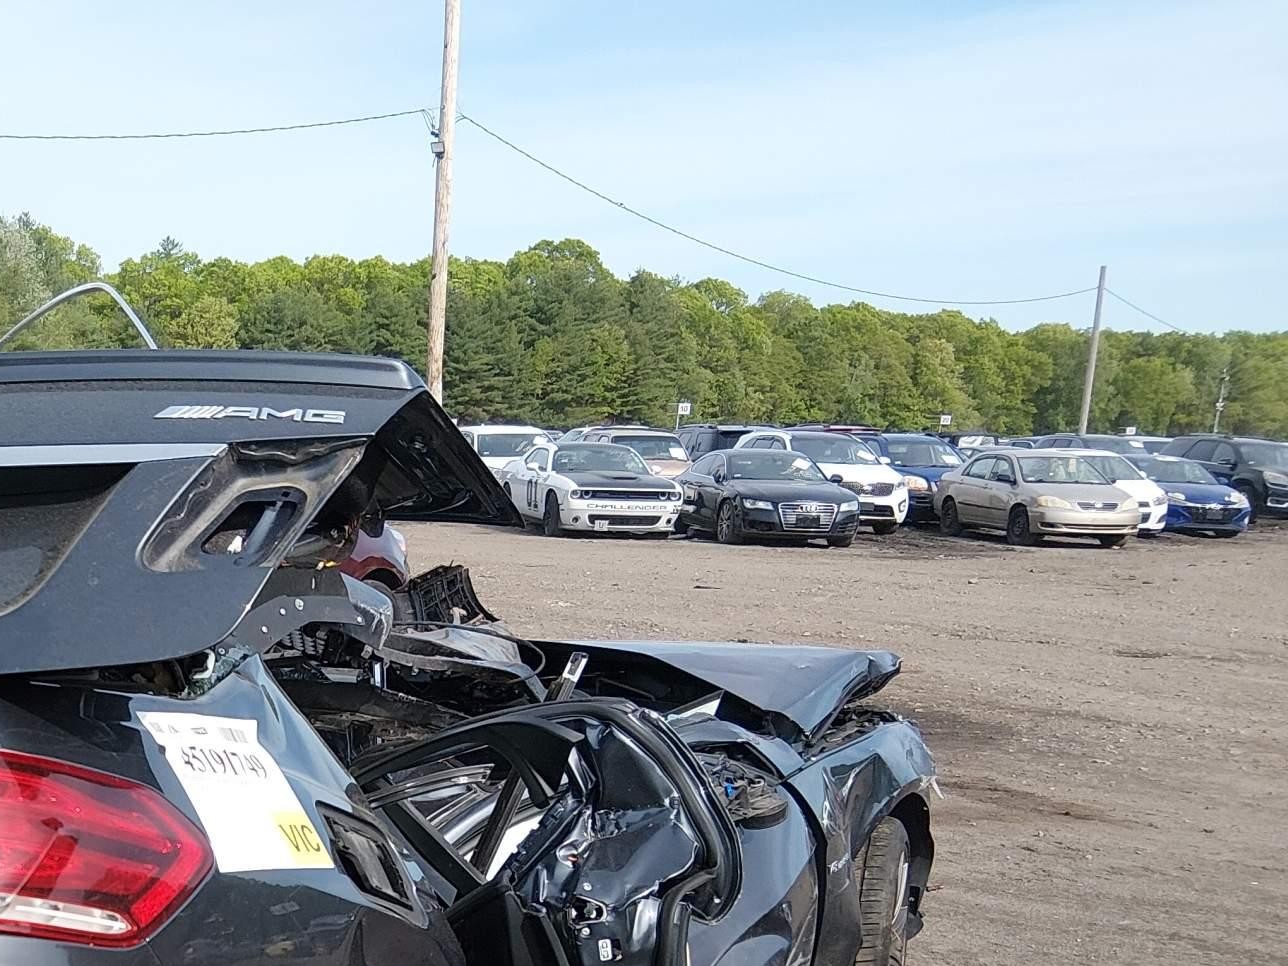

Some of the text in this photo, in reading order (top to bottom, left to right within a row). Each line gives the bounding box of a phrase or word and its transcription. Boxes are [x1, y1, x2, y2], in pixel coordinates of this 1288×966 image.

[213, 405, 346, 425] AMG
[180, 745, 268, 779] 45191749
[278, 823, 322, 854] VIC
